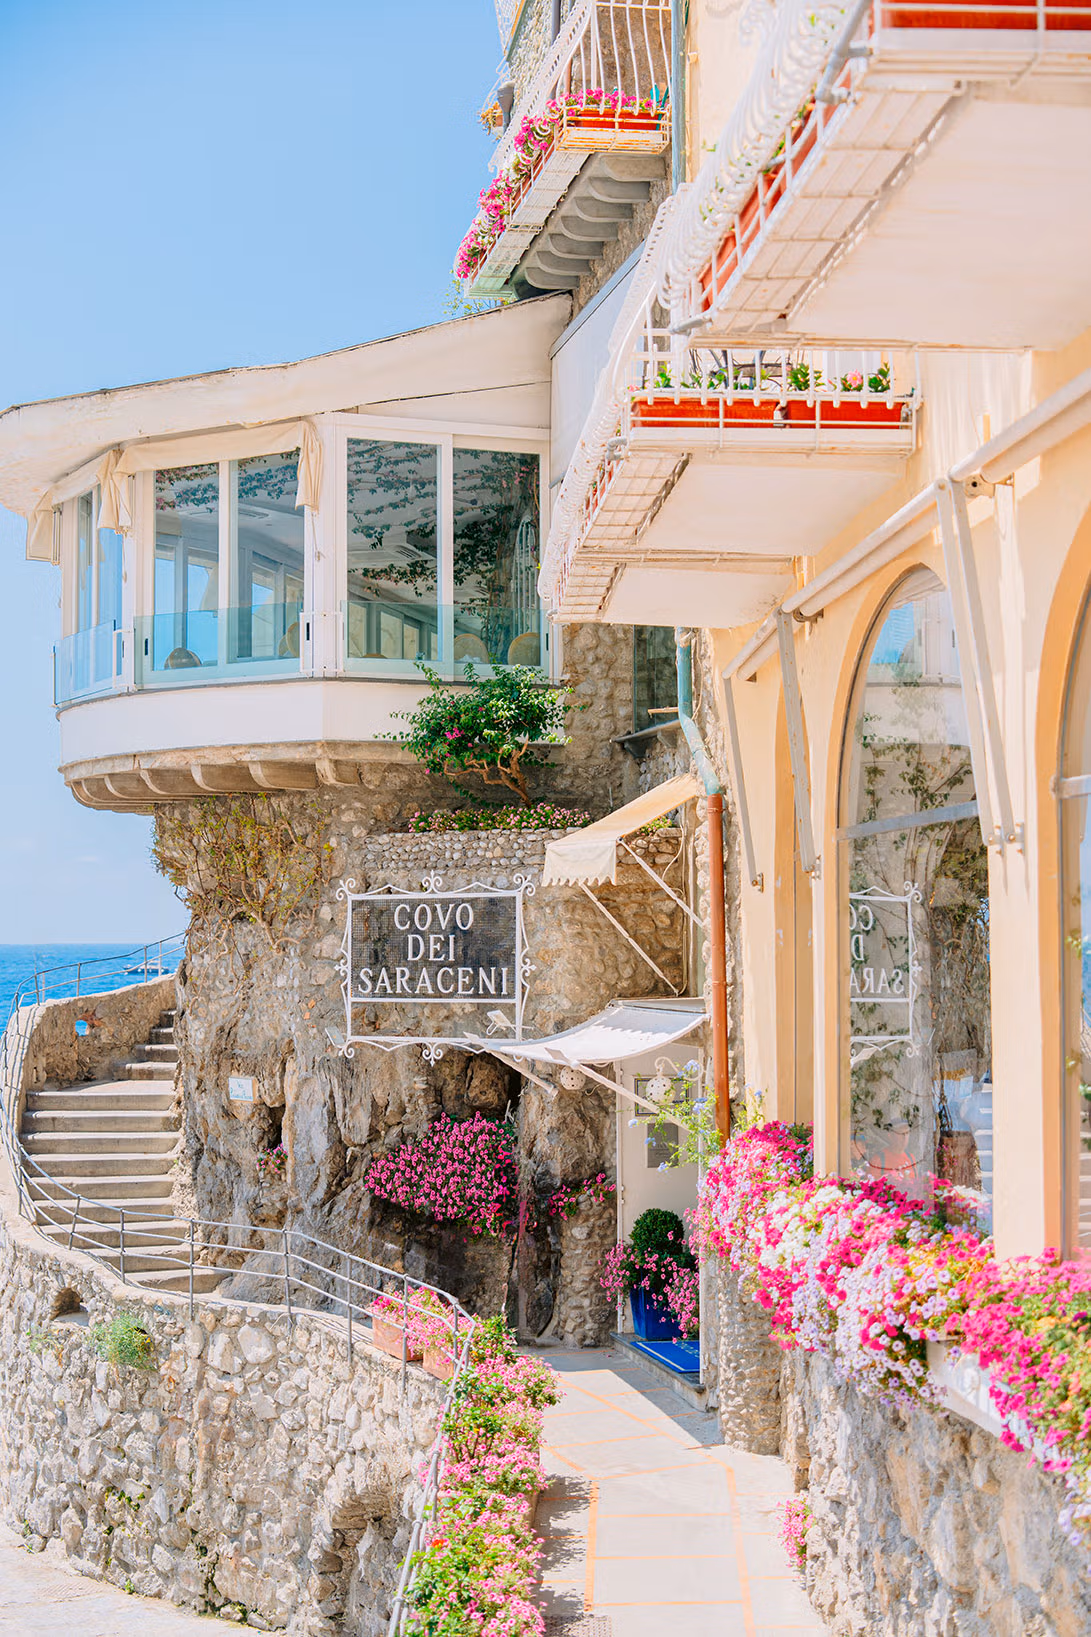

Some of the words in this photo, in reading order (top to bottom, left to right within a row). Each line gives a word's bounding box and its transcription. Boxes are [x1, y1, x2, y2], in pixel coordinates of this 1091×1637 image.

[393, 903, 474, 931] COVO
[407, 934, 455, 961] DEI
[358, 966, 508, 995] SARACENI
